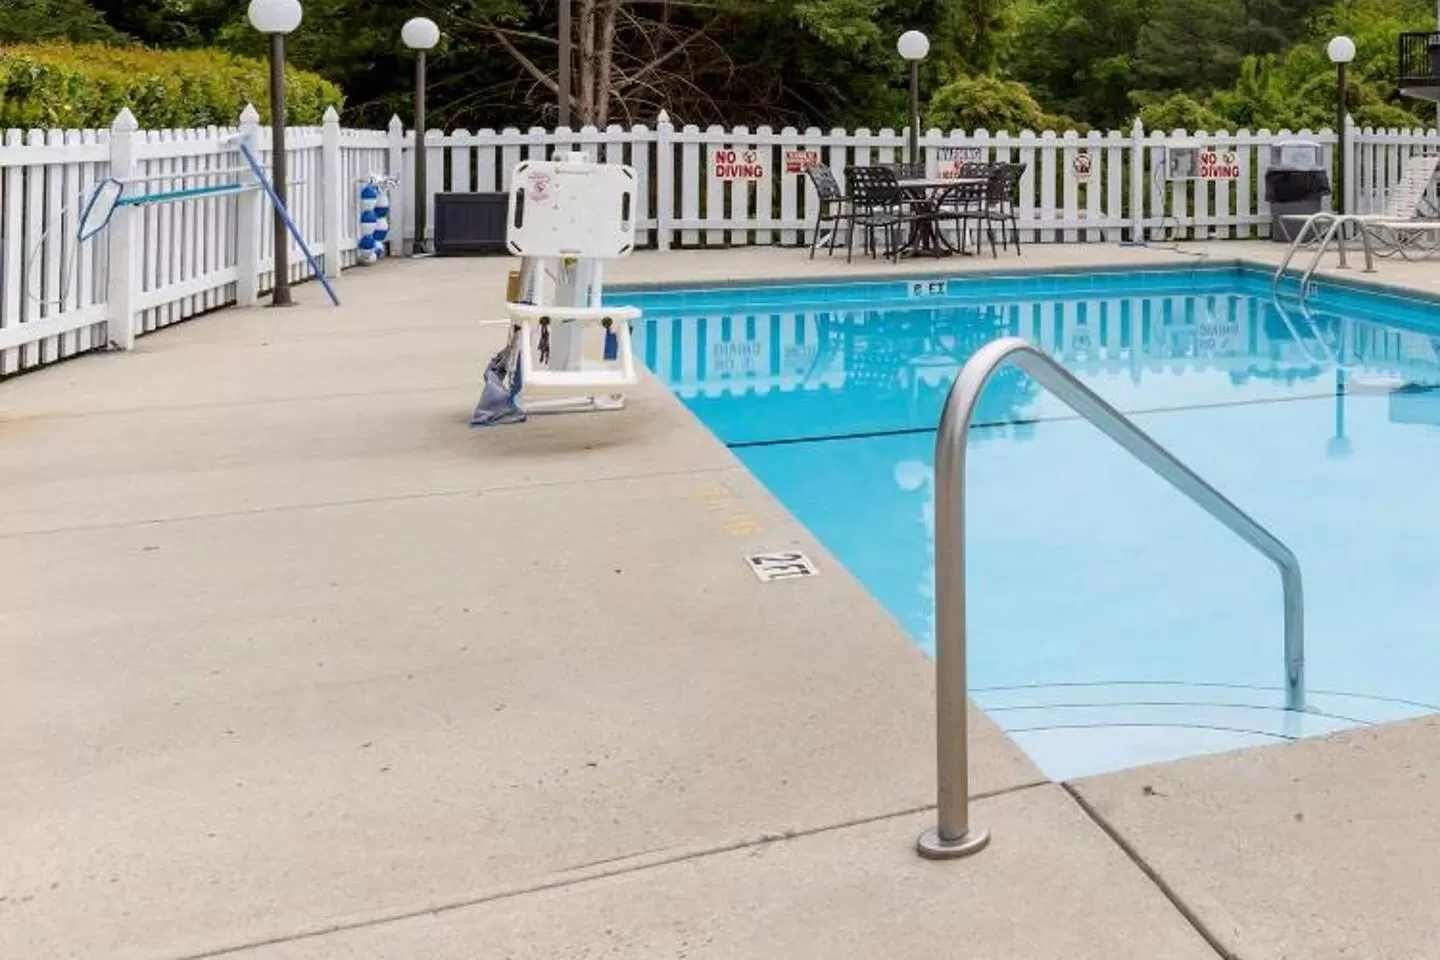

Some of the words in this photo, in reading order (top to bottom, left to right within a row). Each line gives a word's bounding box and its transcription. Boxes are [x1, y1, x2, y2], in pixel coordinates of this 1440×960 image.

[715, 151, 736, 163] NO
[1201, 153, 1217, 165] NO
[715, 165, 763, 178] DIVING
[1201, 166, 1239, 178] DIVING
